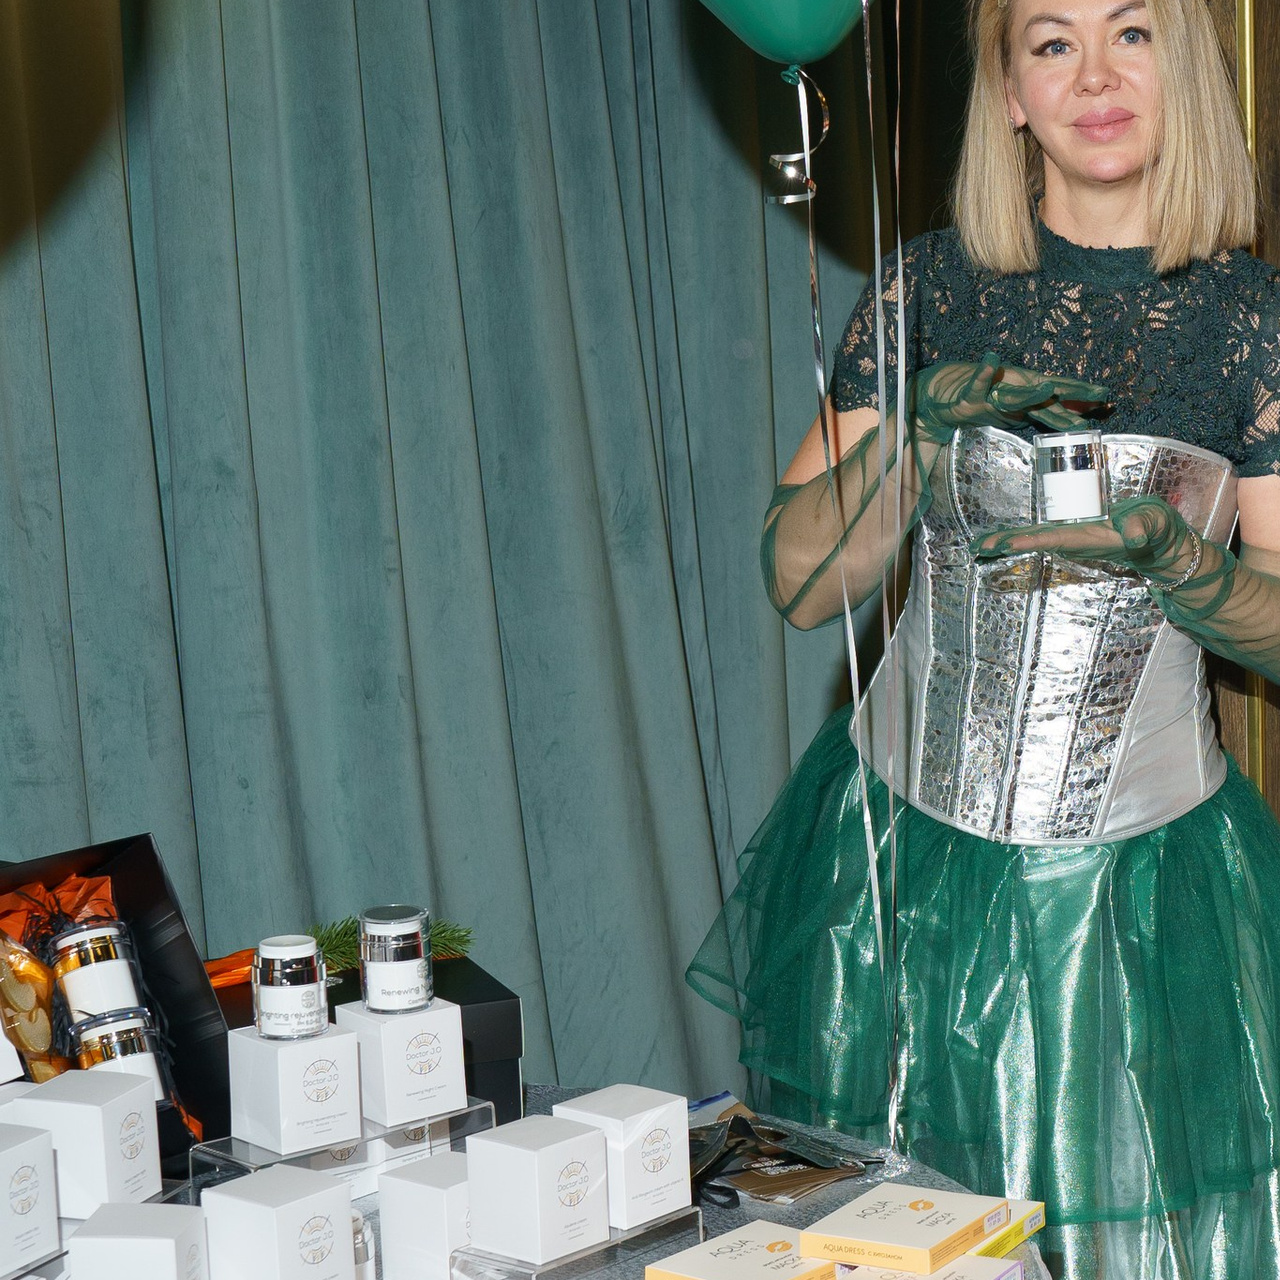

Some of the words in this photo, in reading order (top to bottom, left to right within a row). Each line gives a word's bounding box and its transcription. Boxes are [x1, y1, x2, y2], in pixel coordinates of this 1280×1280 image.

[405, 1051, 429, 1061] Doctor
[709, 1239, 754, 1258] AQUA
[823, 1243, 844, 1254] AQUA
[844, 1245, 865, 1256] DRESS
